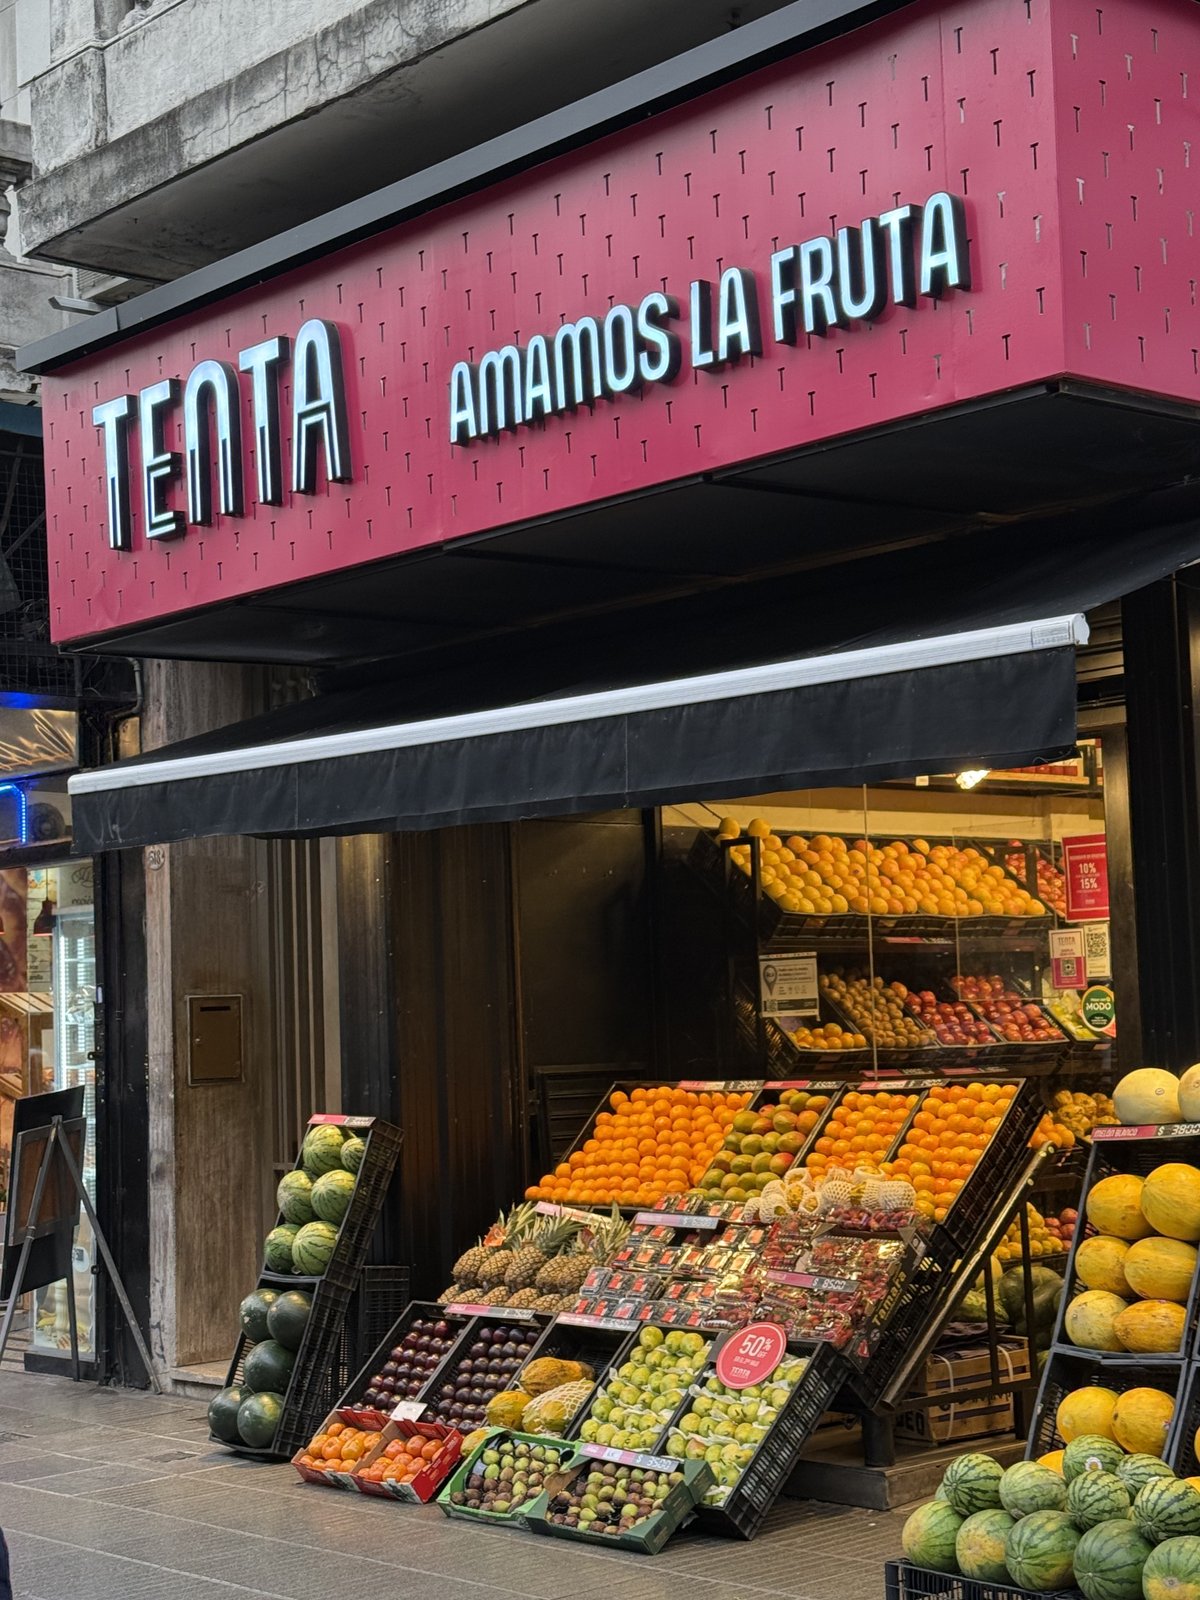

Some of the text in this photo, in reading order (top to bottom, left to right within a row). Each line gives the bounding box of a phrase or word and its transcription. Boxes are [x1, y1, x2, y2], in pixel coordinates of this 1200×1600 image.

[449, 191, 967, 446] AMAMOS LA FRUTA
[92, 318, 350, 551] TENTA
[1078, 862, 1097, 874] 10%
[1080, 878, 1098, 889] 15%
[1086, 1002, 1111, 1011] MODO
[1157, 1126, 1165, 1136] $
[1171, 1123, 1200, 1135] 3800
[812, 1277, 847, 1290] $ 8500
[872, 1271, 907, 1326] Tamara
[738, 1333, 775, 1357] 50%
[636, 1453, 642, 1464] $
